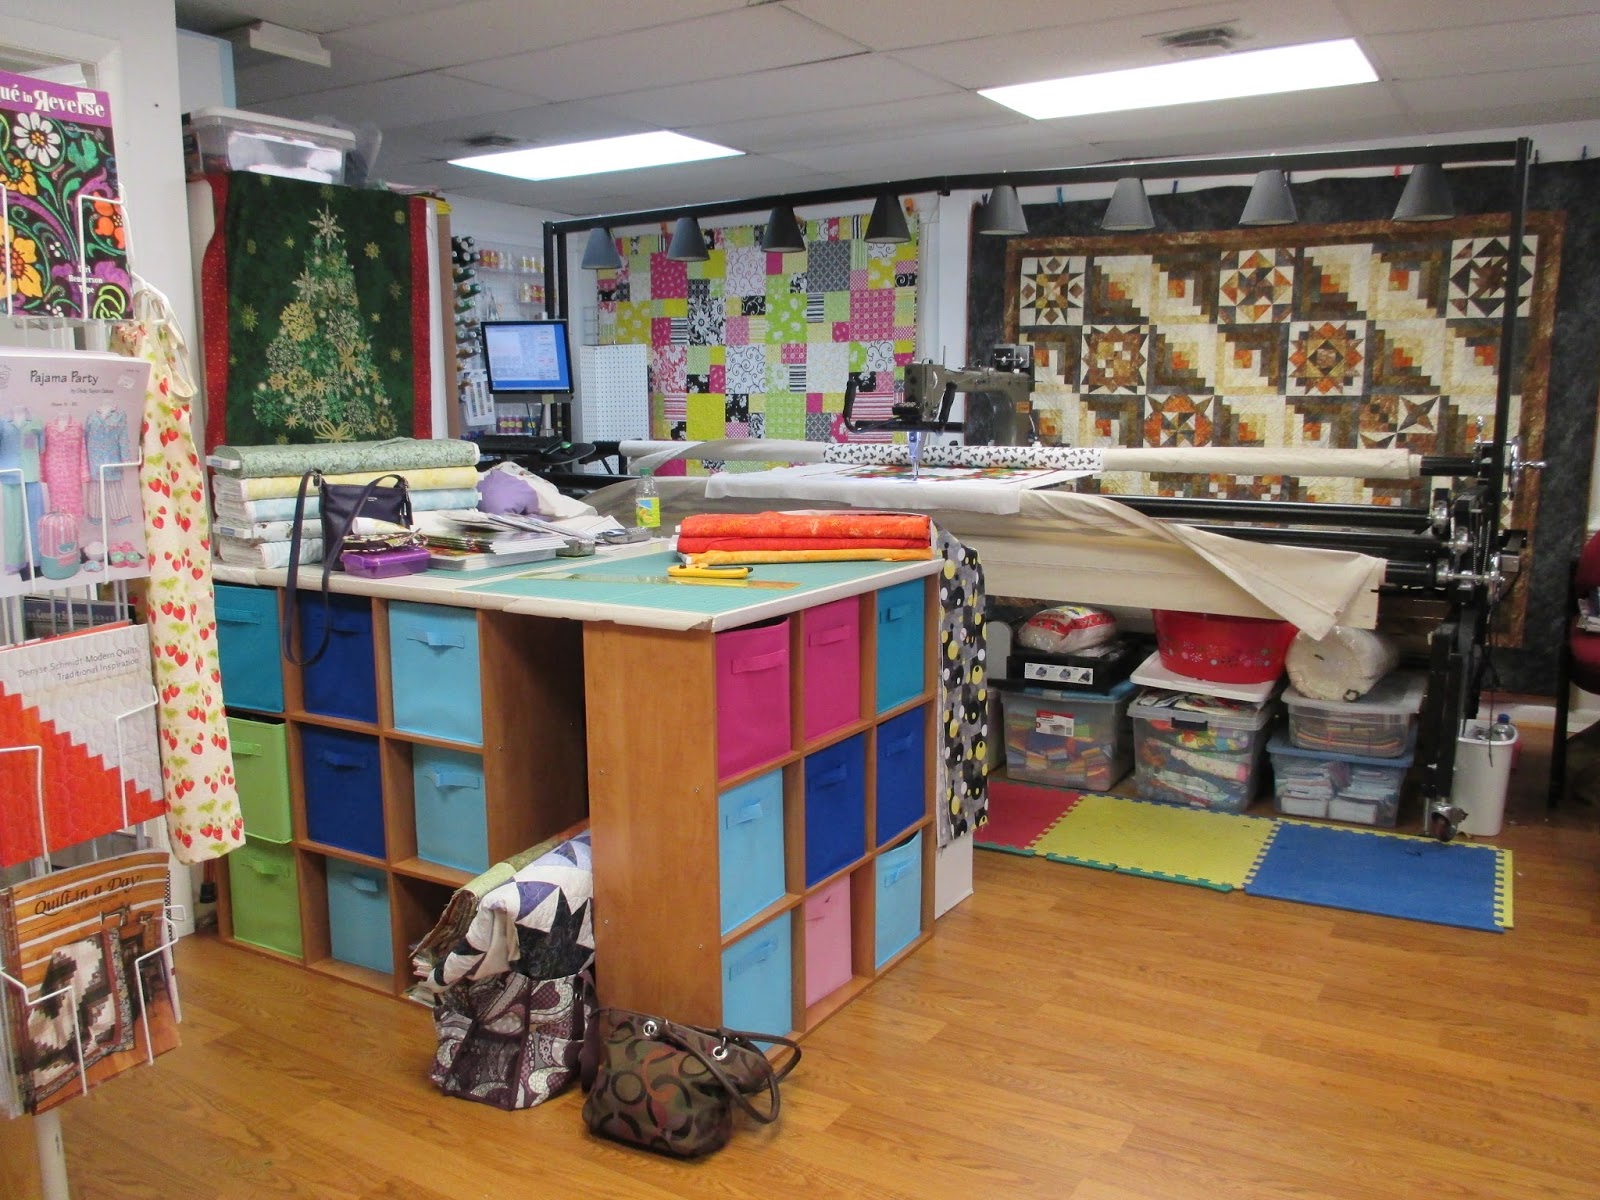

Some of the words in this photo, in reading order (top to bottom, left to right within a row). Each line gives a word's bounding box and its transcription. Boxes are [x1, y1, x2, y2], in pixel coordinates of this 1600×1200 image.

[22, 91, 34, 103] in
[30, 369, 68, 386] Pajama
[71, 370, 99, 386] Party
[17, 665, 48, 679] Denyse
[50, 658, 83, 672] Schmidt
[85, 651, 115, 664] Modern
[116, 646, 139, 658] Quilts
[57, 665, 99, 680] Traditional
[100, 657, 141, 671] Inspiration
[34, 890, 72, 917] Quilt
[75, 888, 89, 901] in
[93, 885, 103, 896] a
[107, 876, 139, 894] Day
